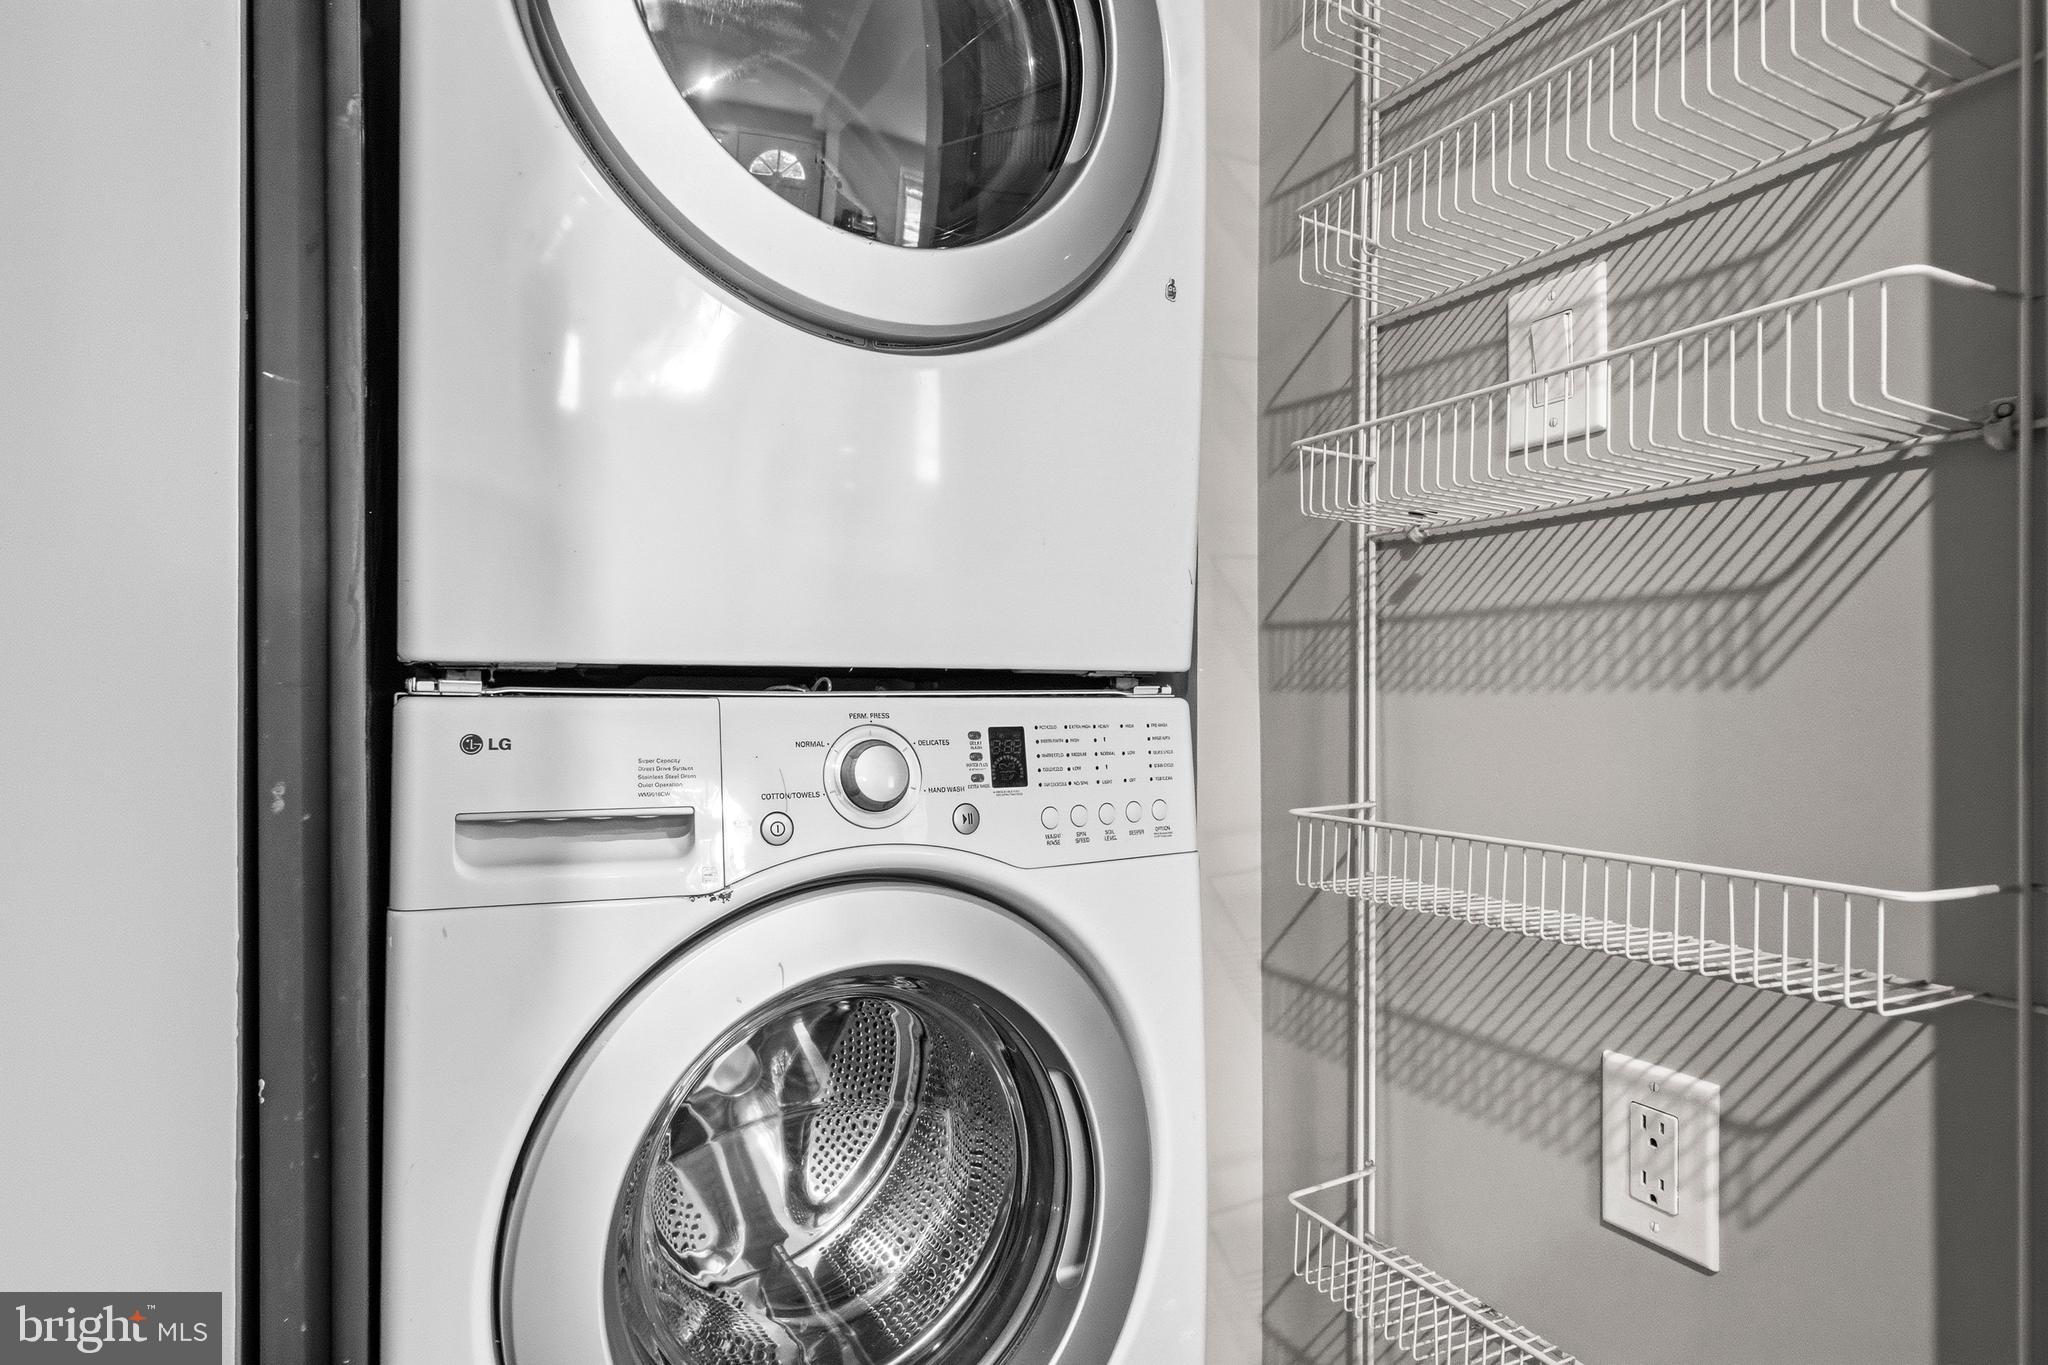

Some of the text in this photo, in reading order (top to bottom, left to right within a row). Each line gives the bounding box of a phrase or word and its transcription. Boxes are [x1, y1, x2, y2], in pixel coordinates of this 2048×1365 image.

[849, 712, 868, 720] PERM.
[488, 738, 512, 751] LG
[795, 740, 825, 748] NORMAL
[946, 785, 965, 793] WASH
[761, 791, 820, 800] COTTON/TOWELS
